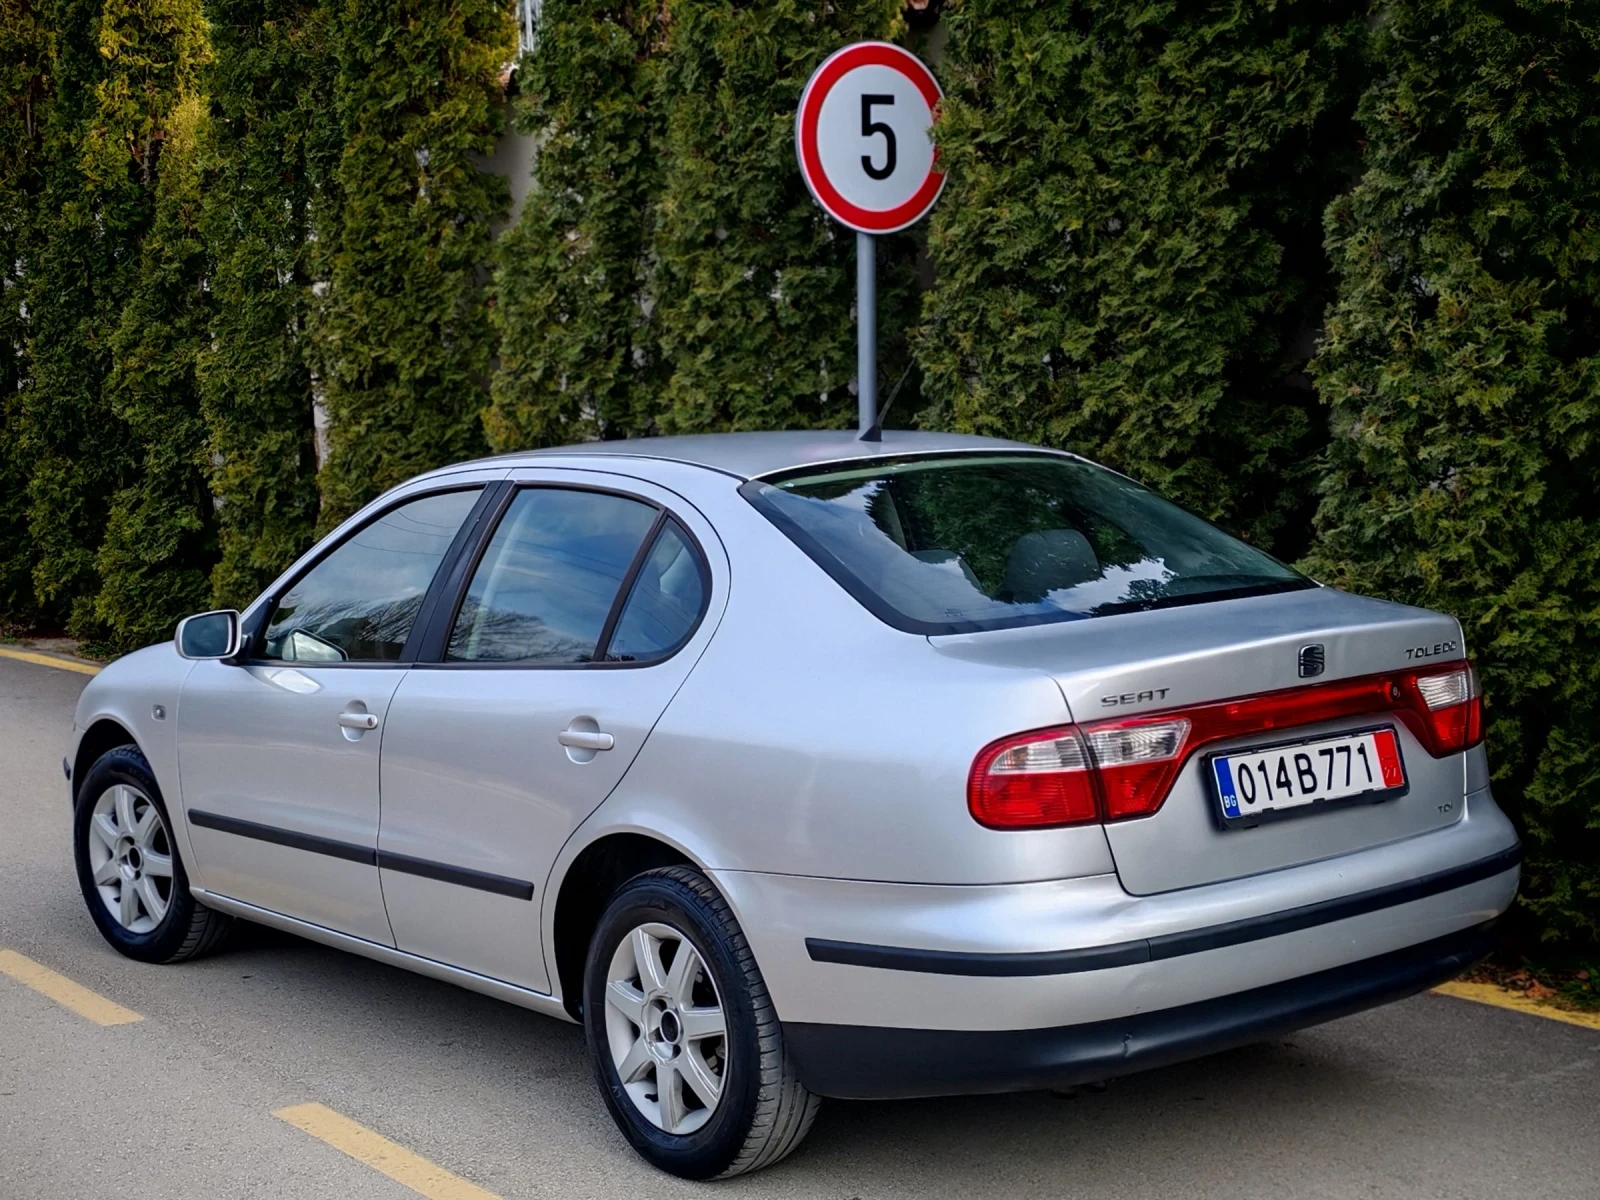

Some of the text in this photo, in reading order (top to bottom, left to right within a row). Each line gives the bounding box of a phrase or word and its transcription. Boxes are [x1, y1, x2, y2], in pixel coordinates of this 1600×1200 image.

[861, 93, 897, 181] 5
[1405, 641, 1457, 660] TOLEDO
[1101, 687, 1171, 708] SEAT
[1238, 742, 1373, 805] 014B771
[1223, 794, 1237, 809] BG
